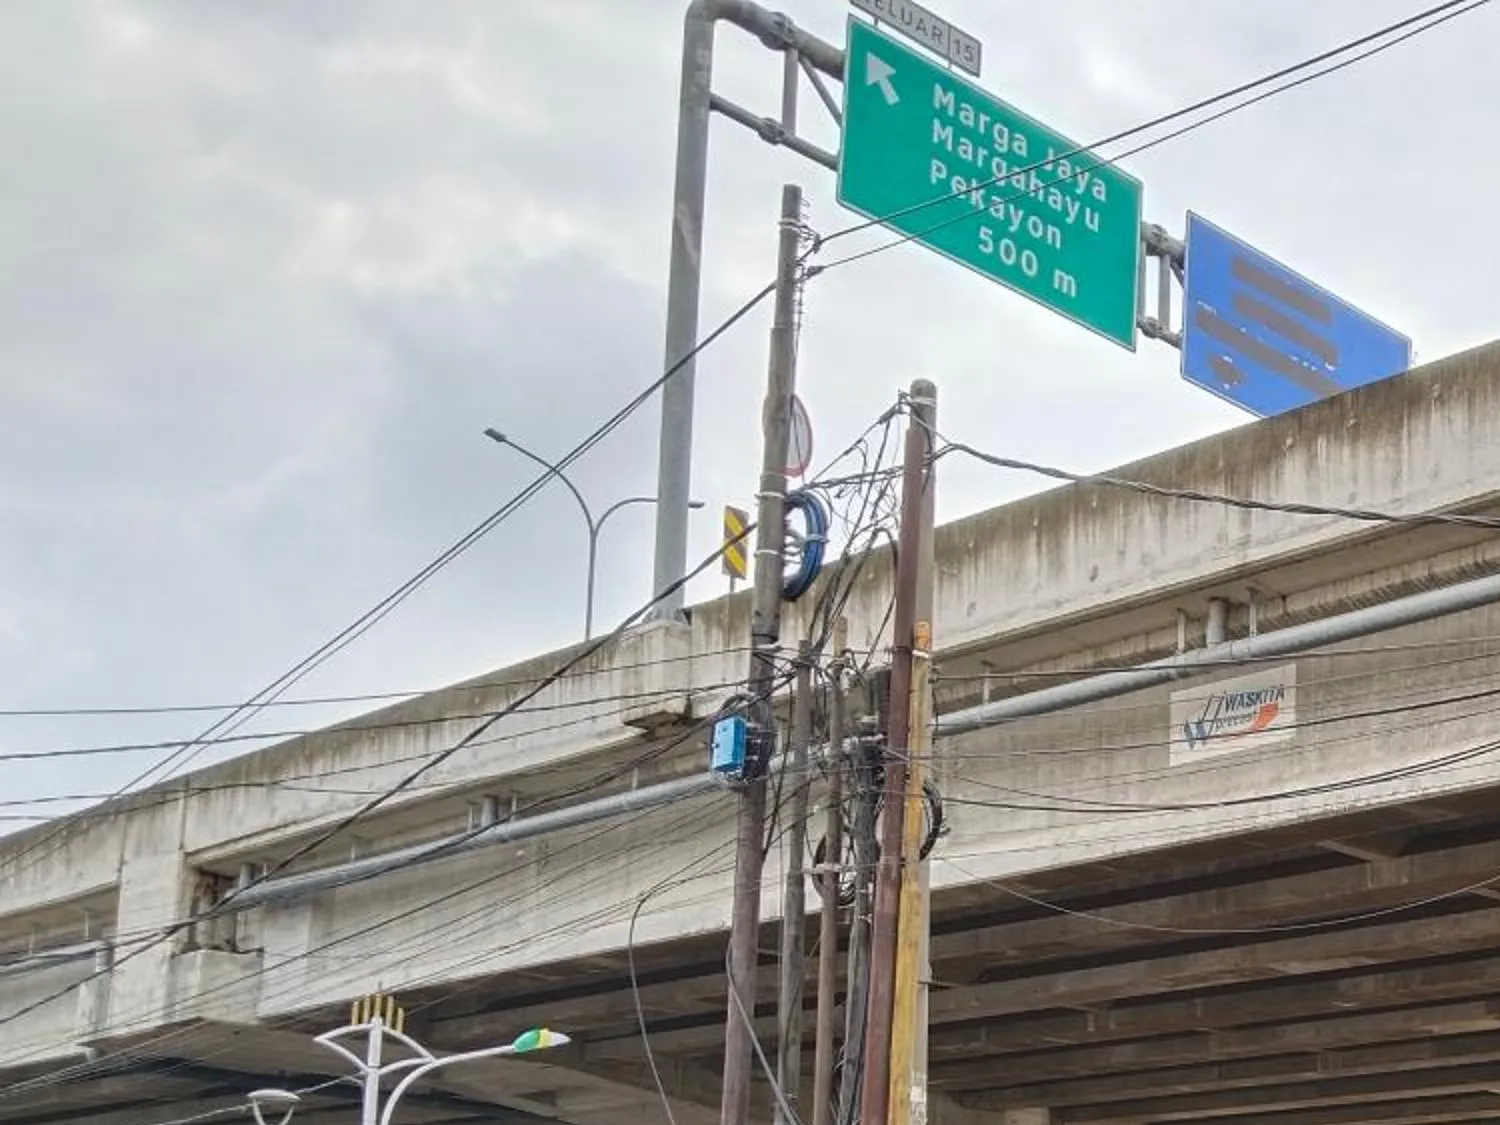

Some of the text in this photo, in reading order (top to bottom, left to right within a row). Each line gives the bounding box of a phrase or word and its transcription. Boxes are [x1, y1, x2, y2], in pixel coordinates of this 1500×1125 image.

[865, 0, 975, 63] ELUAR 15
[932, 118, 1099, 233] Margahayu
[934, 83, 1107, 202] Marga Jaya
[930, 159, 1061, 250] Pekayon
[978, 225, 1077, 298] 500 m
